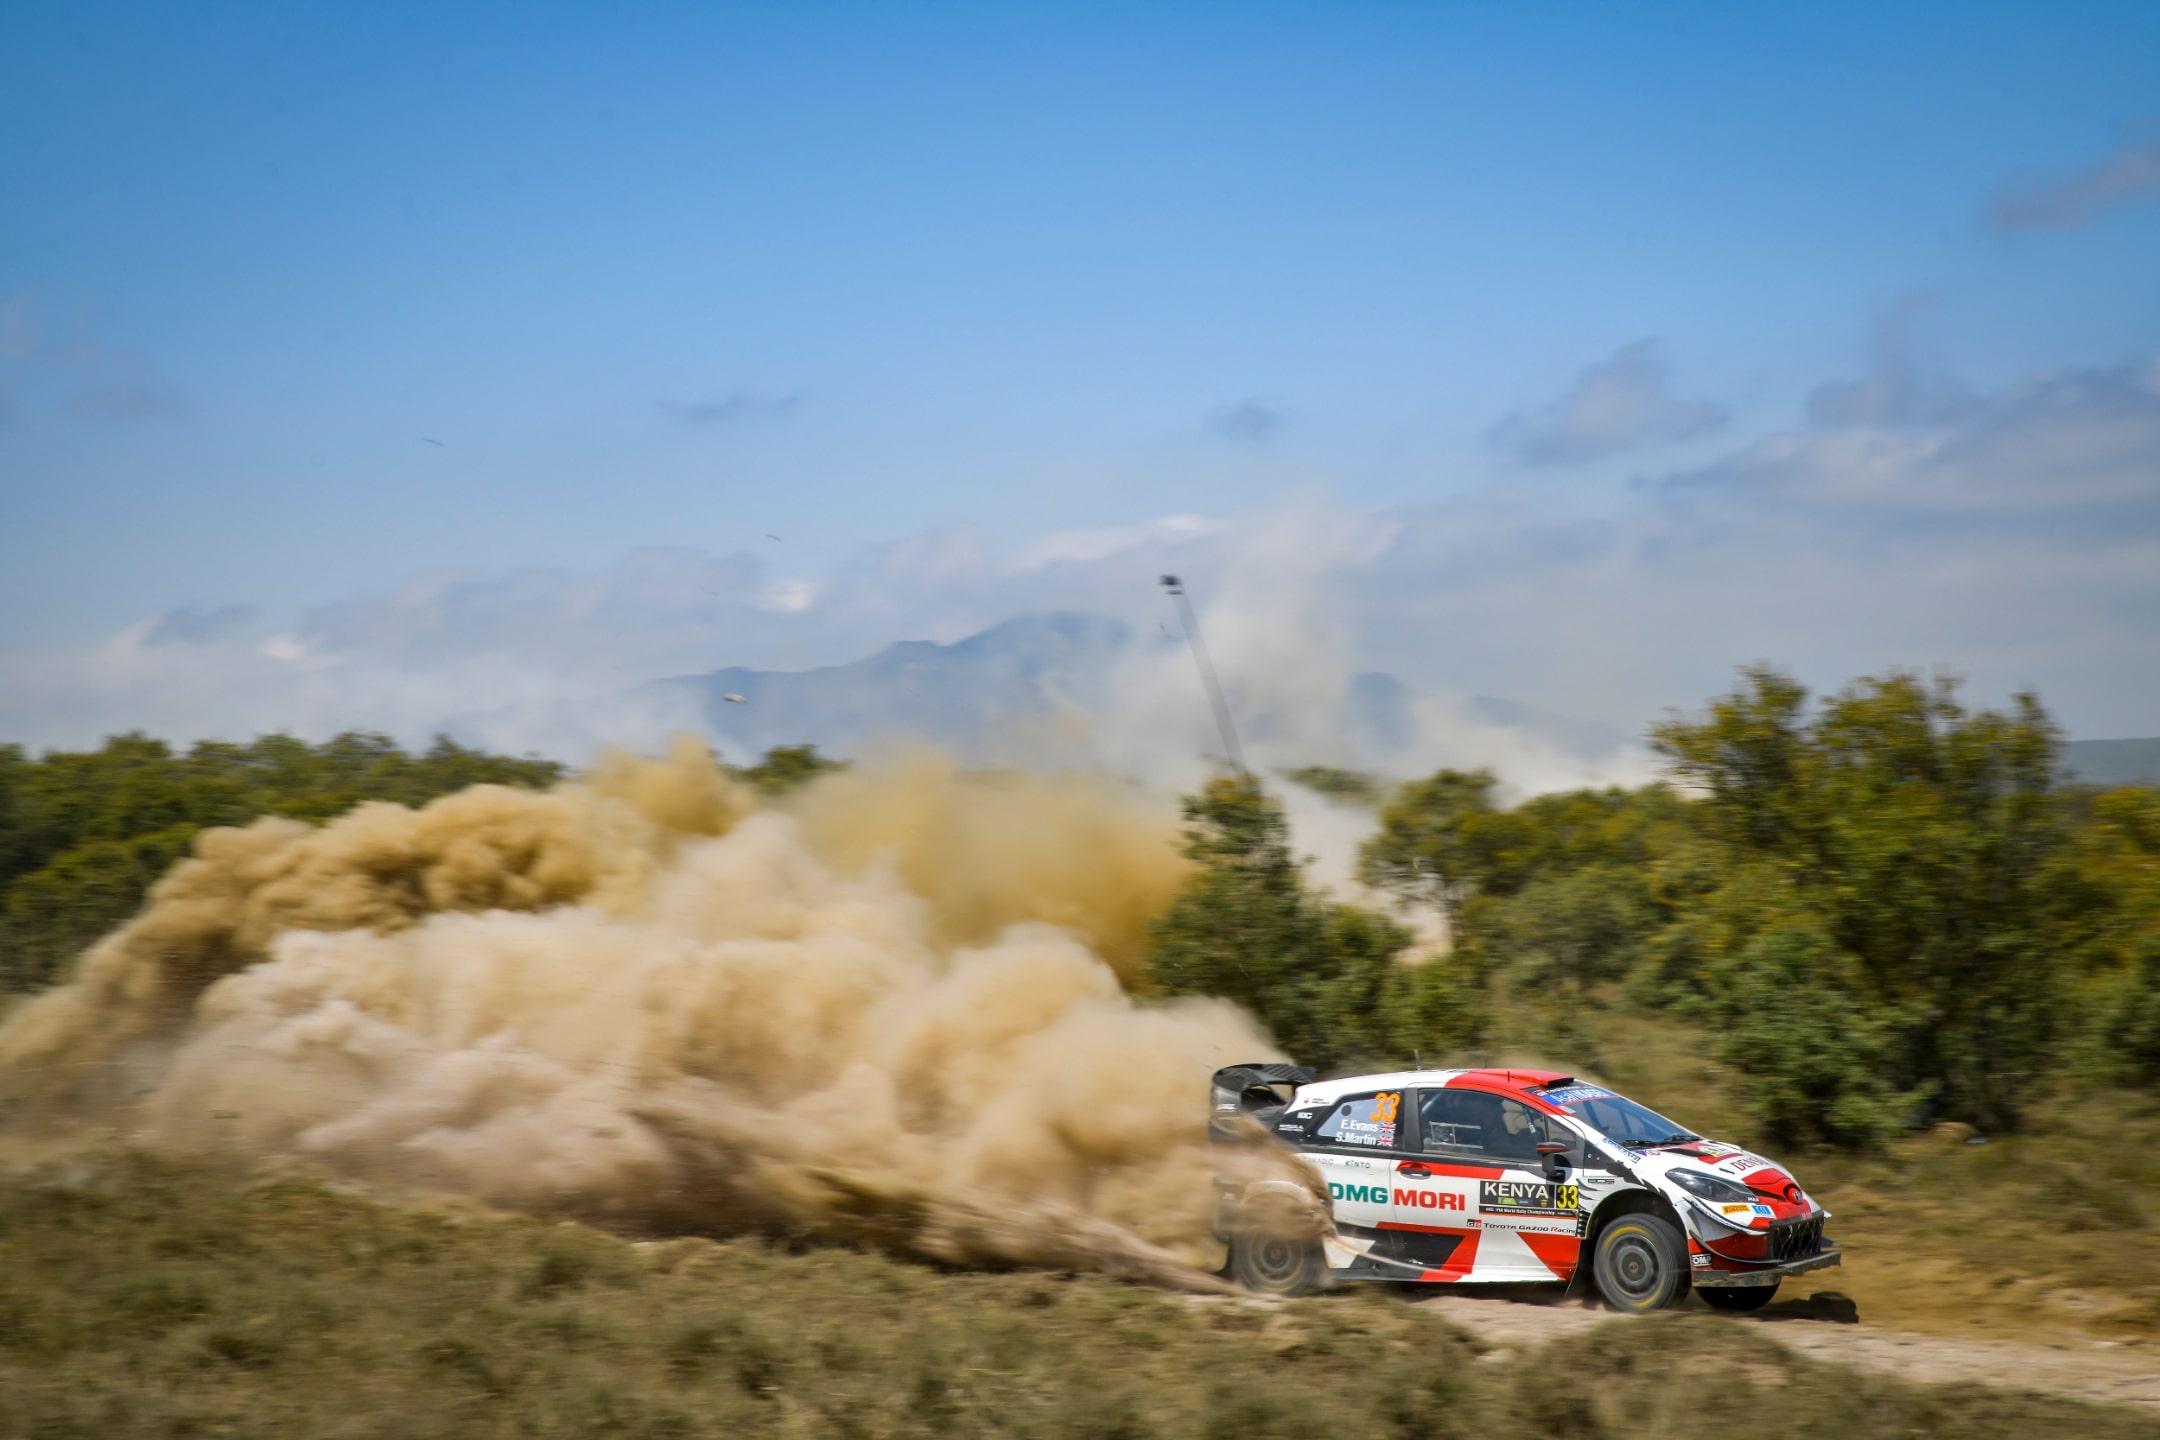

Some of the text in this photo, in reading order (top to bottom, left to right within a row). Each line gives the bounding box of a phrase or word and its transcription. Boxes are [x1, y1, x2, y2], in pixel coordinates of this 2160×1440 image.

[1371, 1092, 1400, 1122] 33
[1341, 1119, 1379, 1132] E.Evans
[1335, 1131, 1377, 1146] S.Martin
[1329, 1182, 1465, 1211] DMG MORI
[1485, 1182, 1578, 1209] KENYA 33
[1483, 1222, 1517, 1230] TOYOTA
[1518, 1224, 1549, 1232] GAZOO
[1692, 1255, 1712, 1265] OMP
